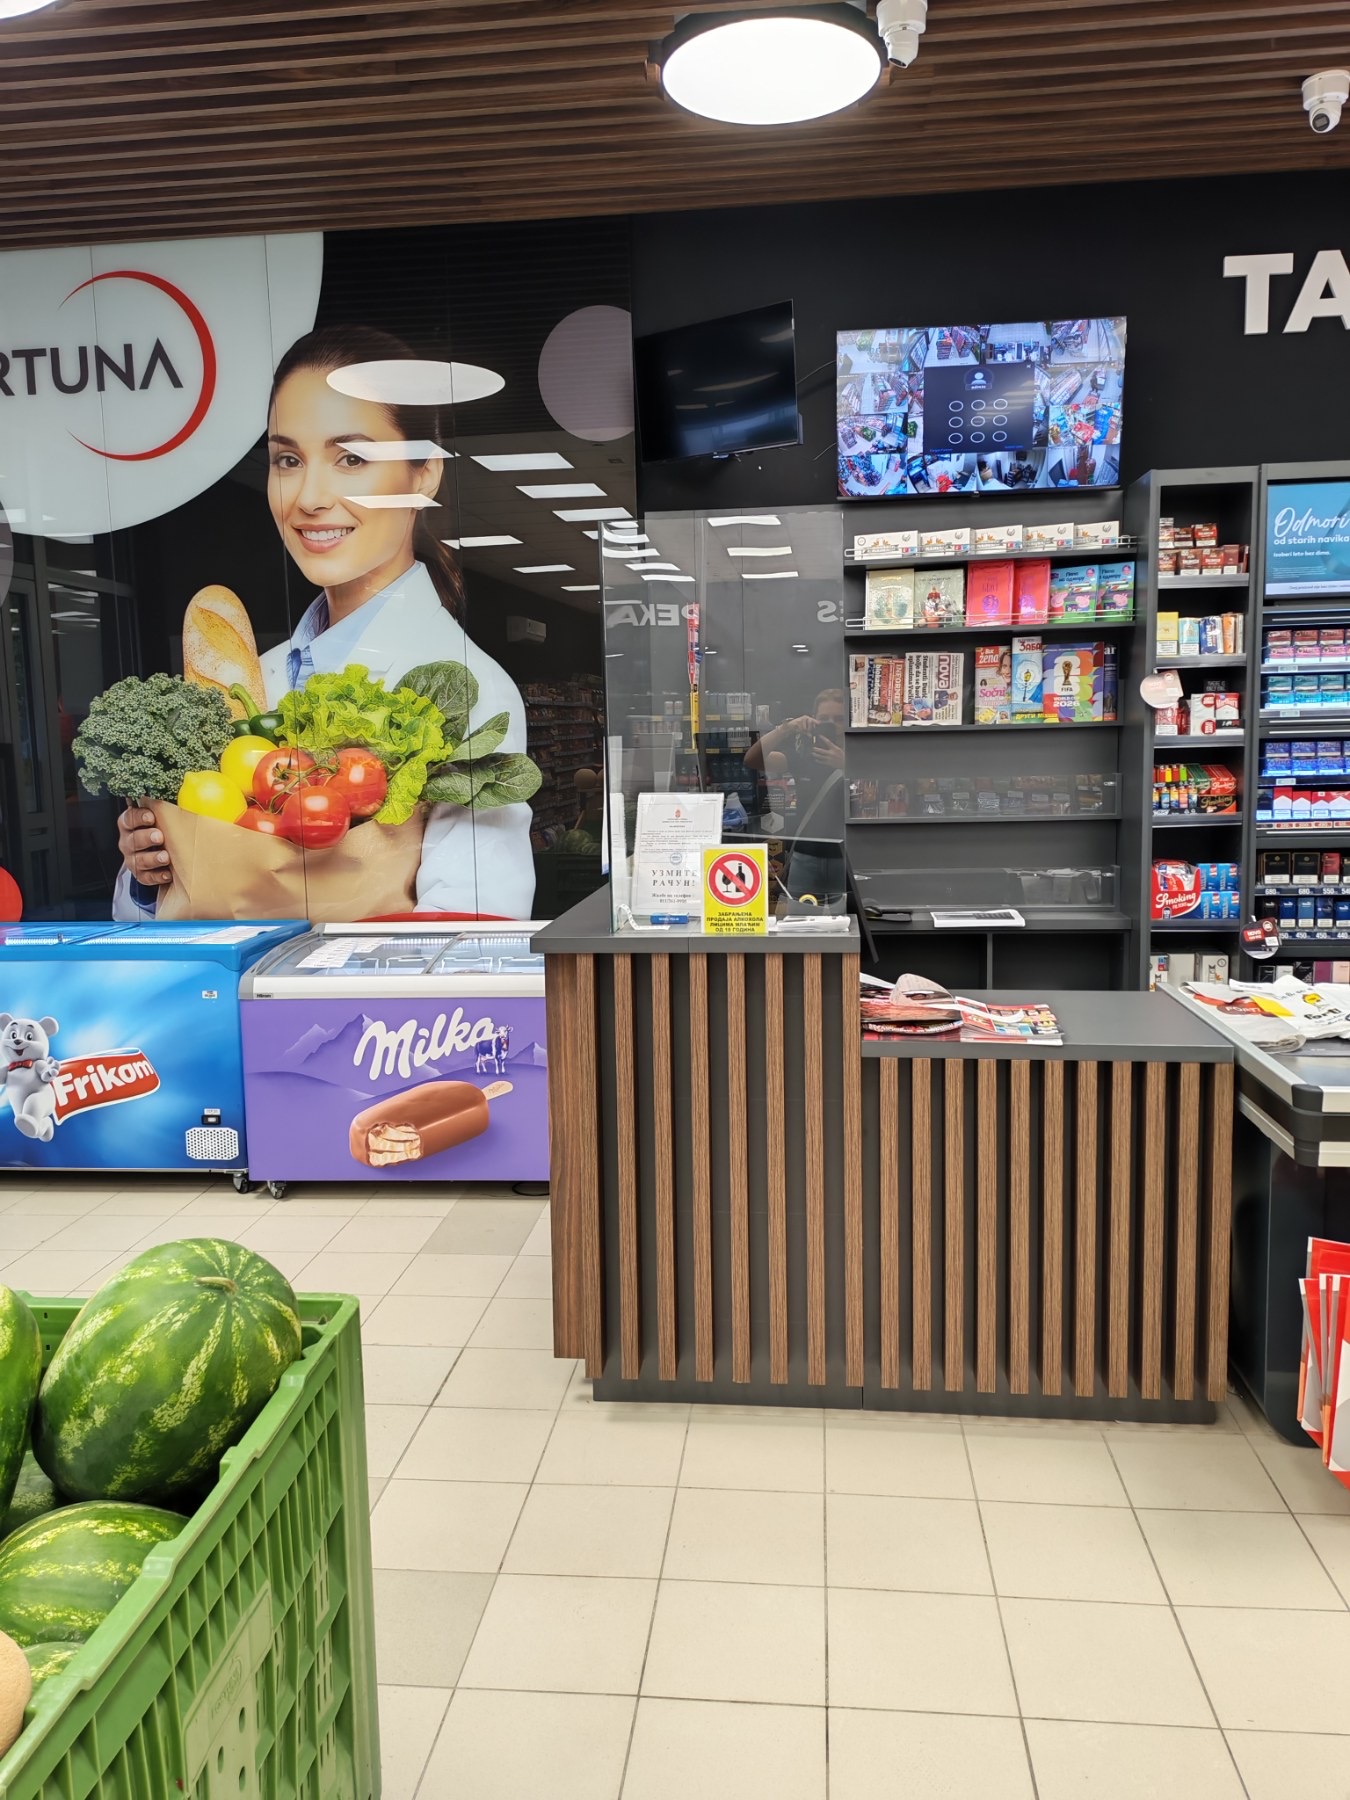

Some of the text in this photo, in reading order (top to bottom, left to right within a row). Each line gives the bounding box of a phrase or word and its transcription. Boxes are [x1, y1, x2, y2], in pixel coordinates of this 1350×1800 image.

[1274, 507, 1350, 538] Odmori
[1274, 533, 1350, 545] od starih navika
[939, 655, 950, 689] nova
[1053, 700, 1080, 708] 2026
[652, 869, 697, 877] УЗМИТЕ
[652, 879, 696, 887] РАЧУН!
[1155, 892, 1197, 909] Smoking
[353, 1007, 498, 1081] Milka
[53, 1058, 154, 1107] Frikom
